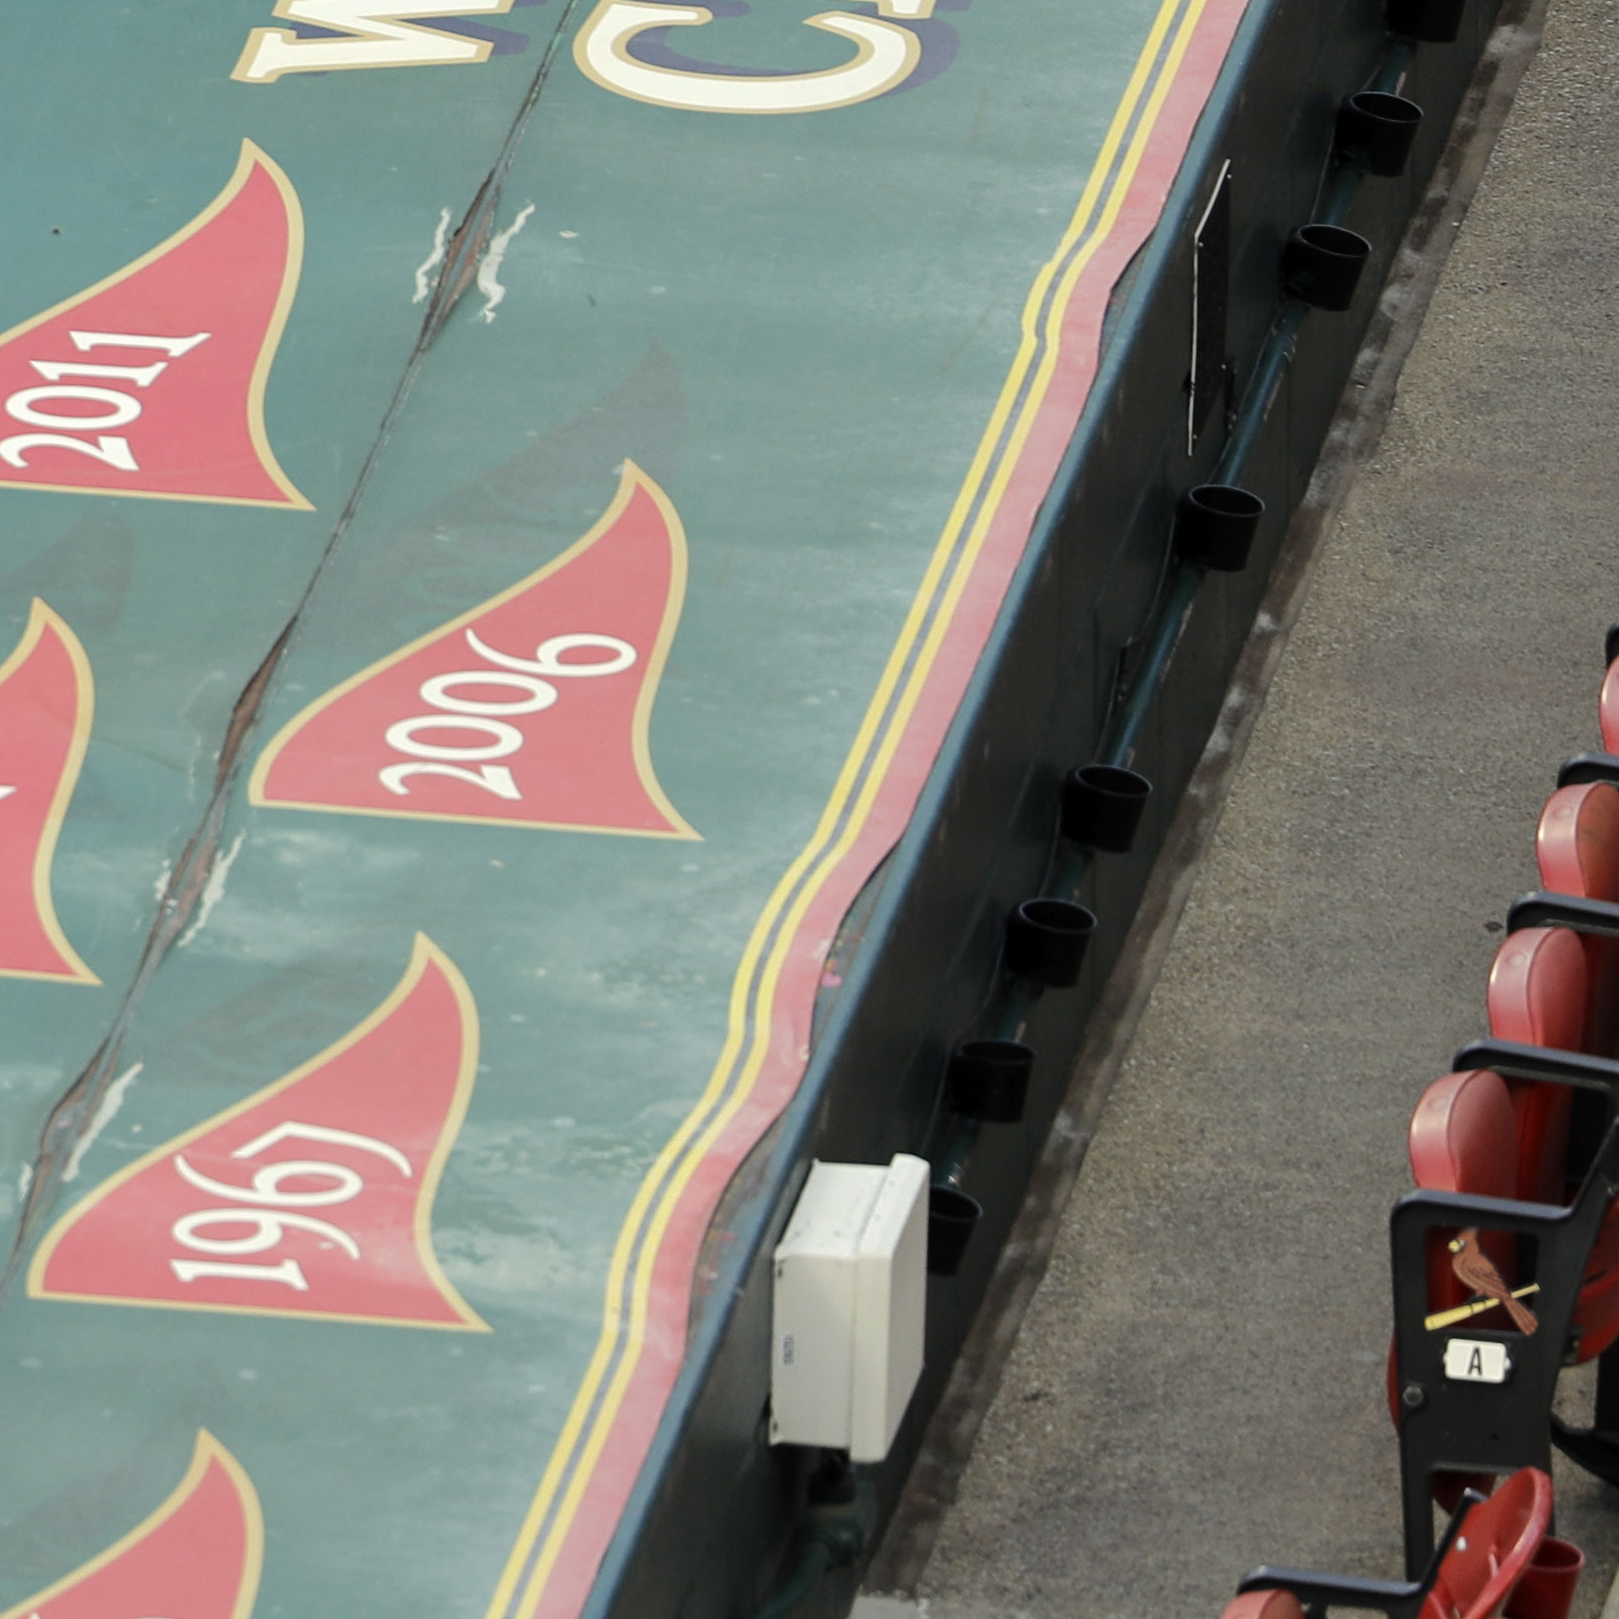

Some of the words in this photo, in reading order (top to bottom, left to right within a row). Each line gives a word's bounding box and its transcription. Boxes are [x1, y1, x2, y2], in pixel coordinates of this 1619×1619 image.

[378, 628, 638, 801] 2006
[170, 1121, 412, 1292] 1967
[1468, 1346, 1483, 1376] A
